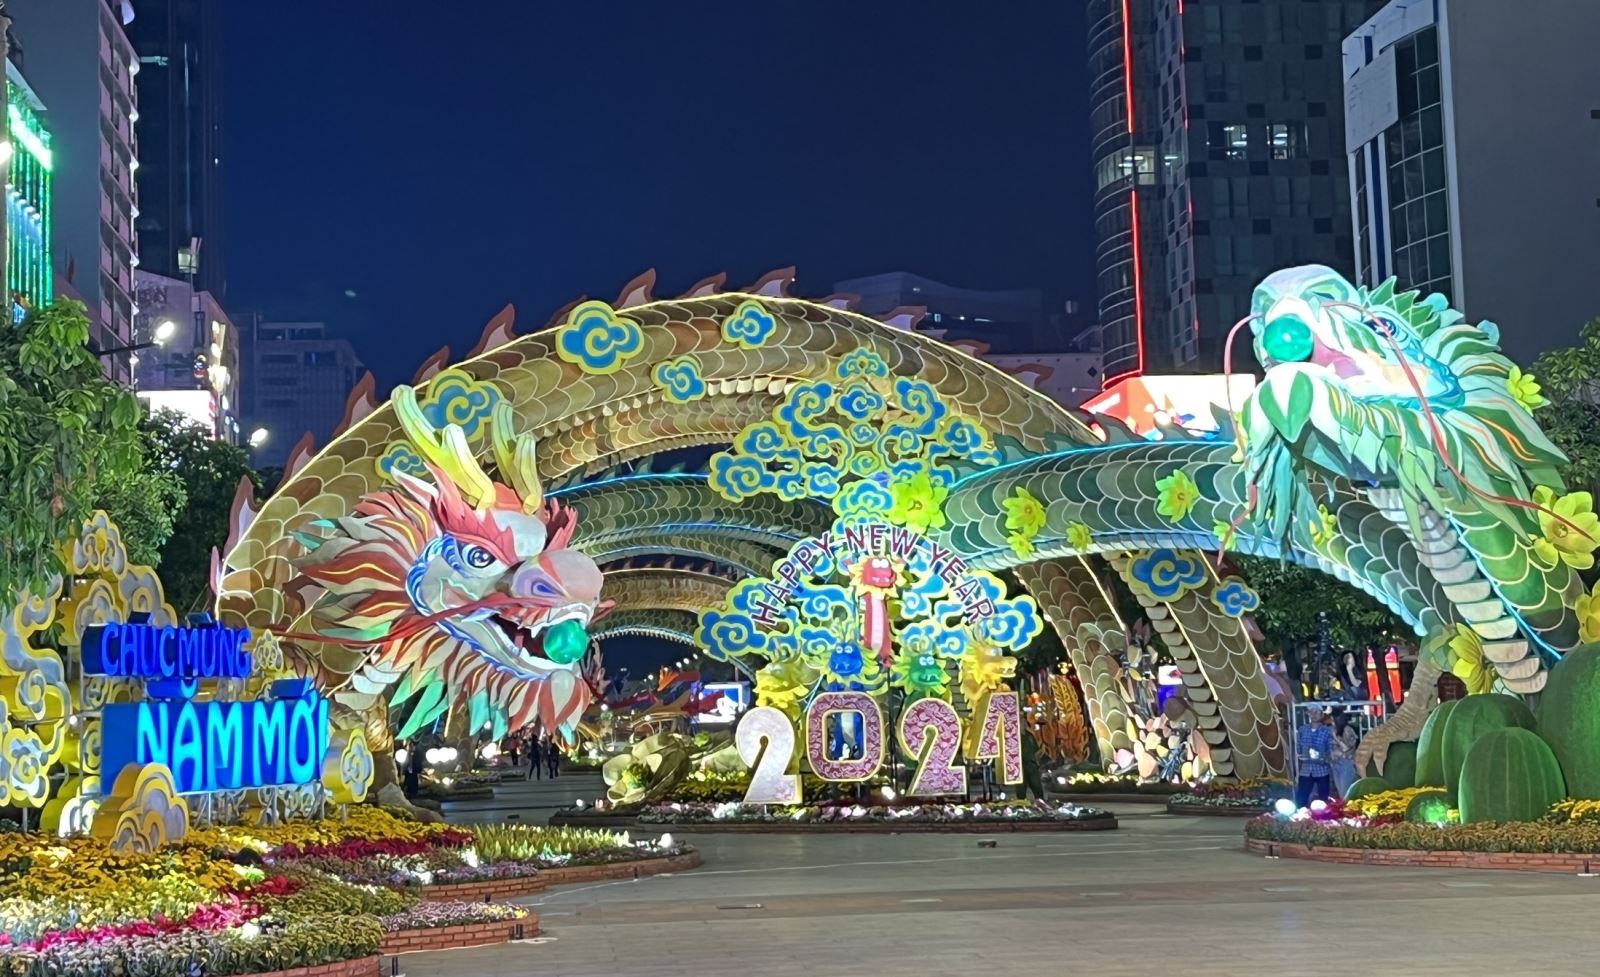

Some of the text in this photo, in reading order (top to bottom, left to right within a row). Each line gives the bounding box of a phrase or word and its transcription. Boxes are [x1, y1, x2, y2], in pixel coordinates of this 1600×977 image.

[751, 524, 994, 627] HAPPY NEW YEAR
[137, 679, 242, 793] NĂM
[735, 691, 1024, 804] 2024
